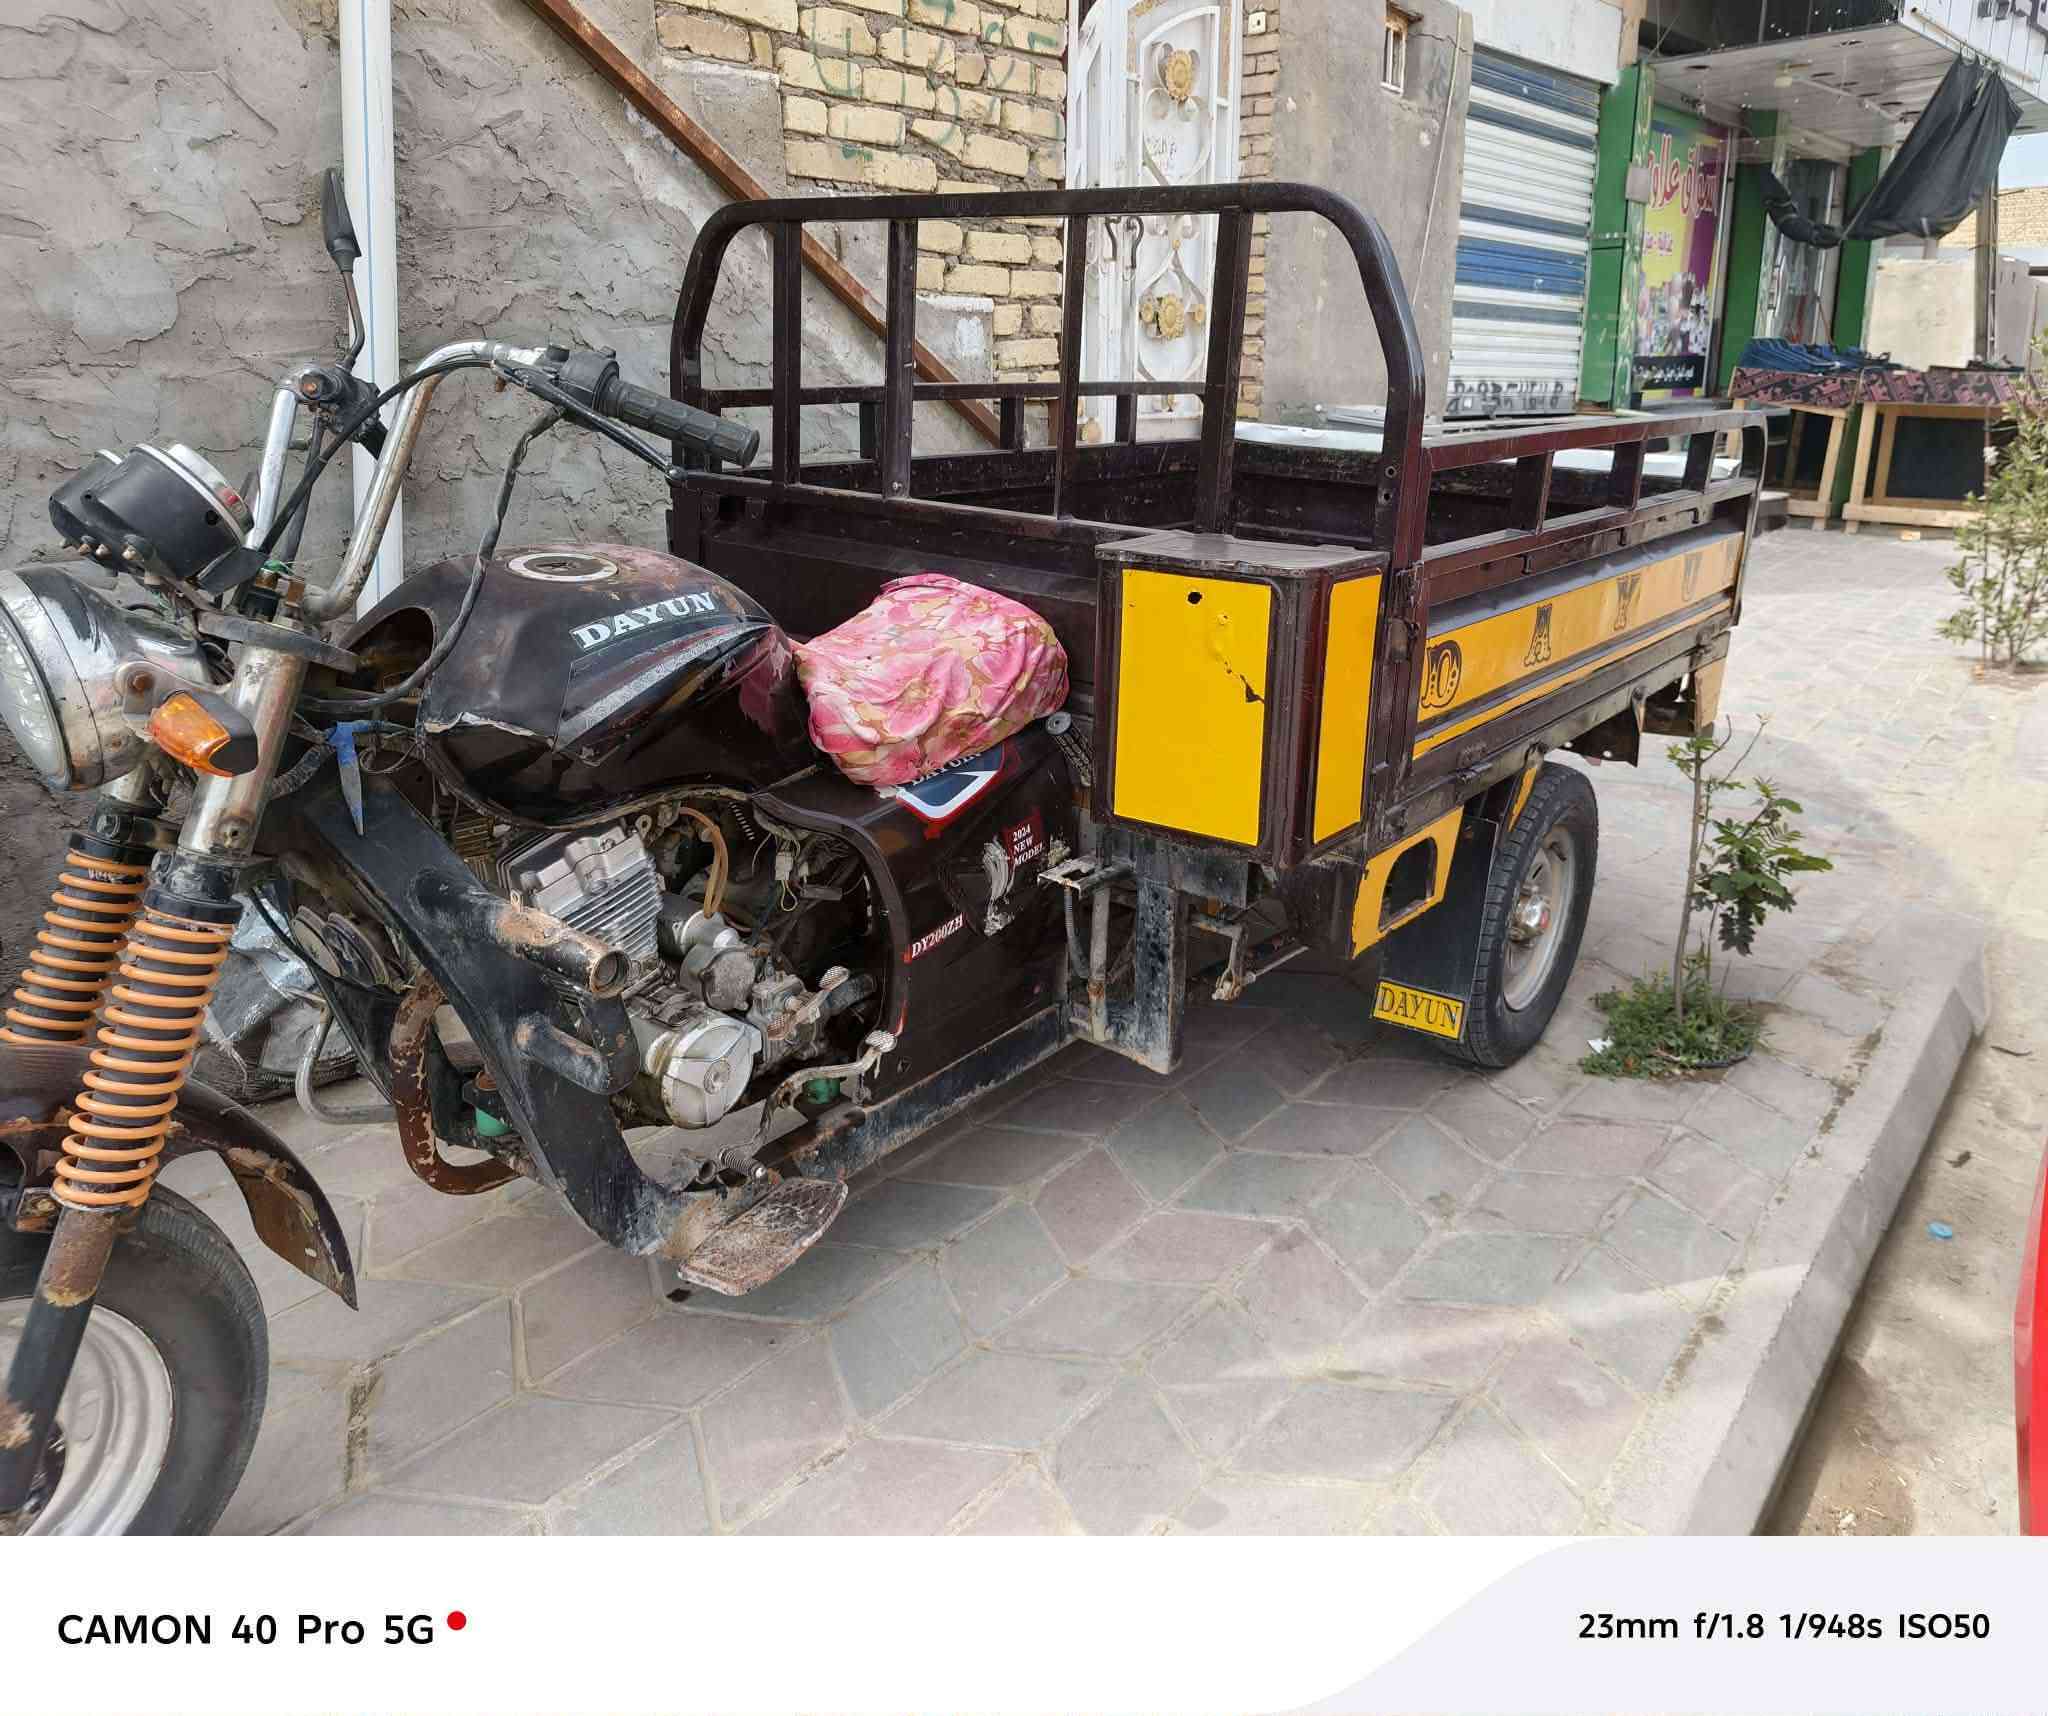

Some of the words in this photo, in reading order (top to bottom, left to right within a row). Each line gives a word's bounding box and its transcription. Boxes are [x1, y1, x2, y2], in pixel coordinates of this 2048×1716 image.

[572, 591, 717, 649] DAYUN
[1013, 824, 1031, 842] 2024
[1013, 834, 1034, 855] NEW
[1014, 841, 1044, 866] MODEL
[911, 912, 964, 959] DY200ZH
[1377, 985, 1461, 1031] DAYUN
